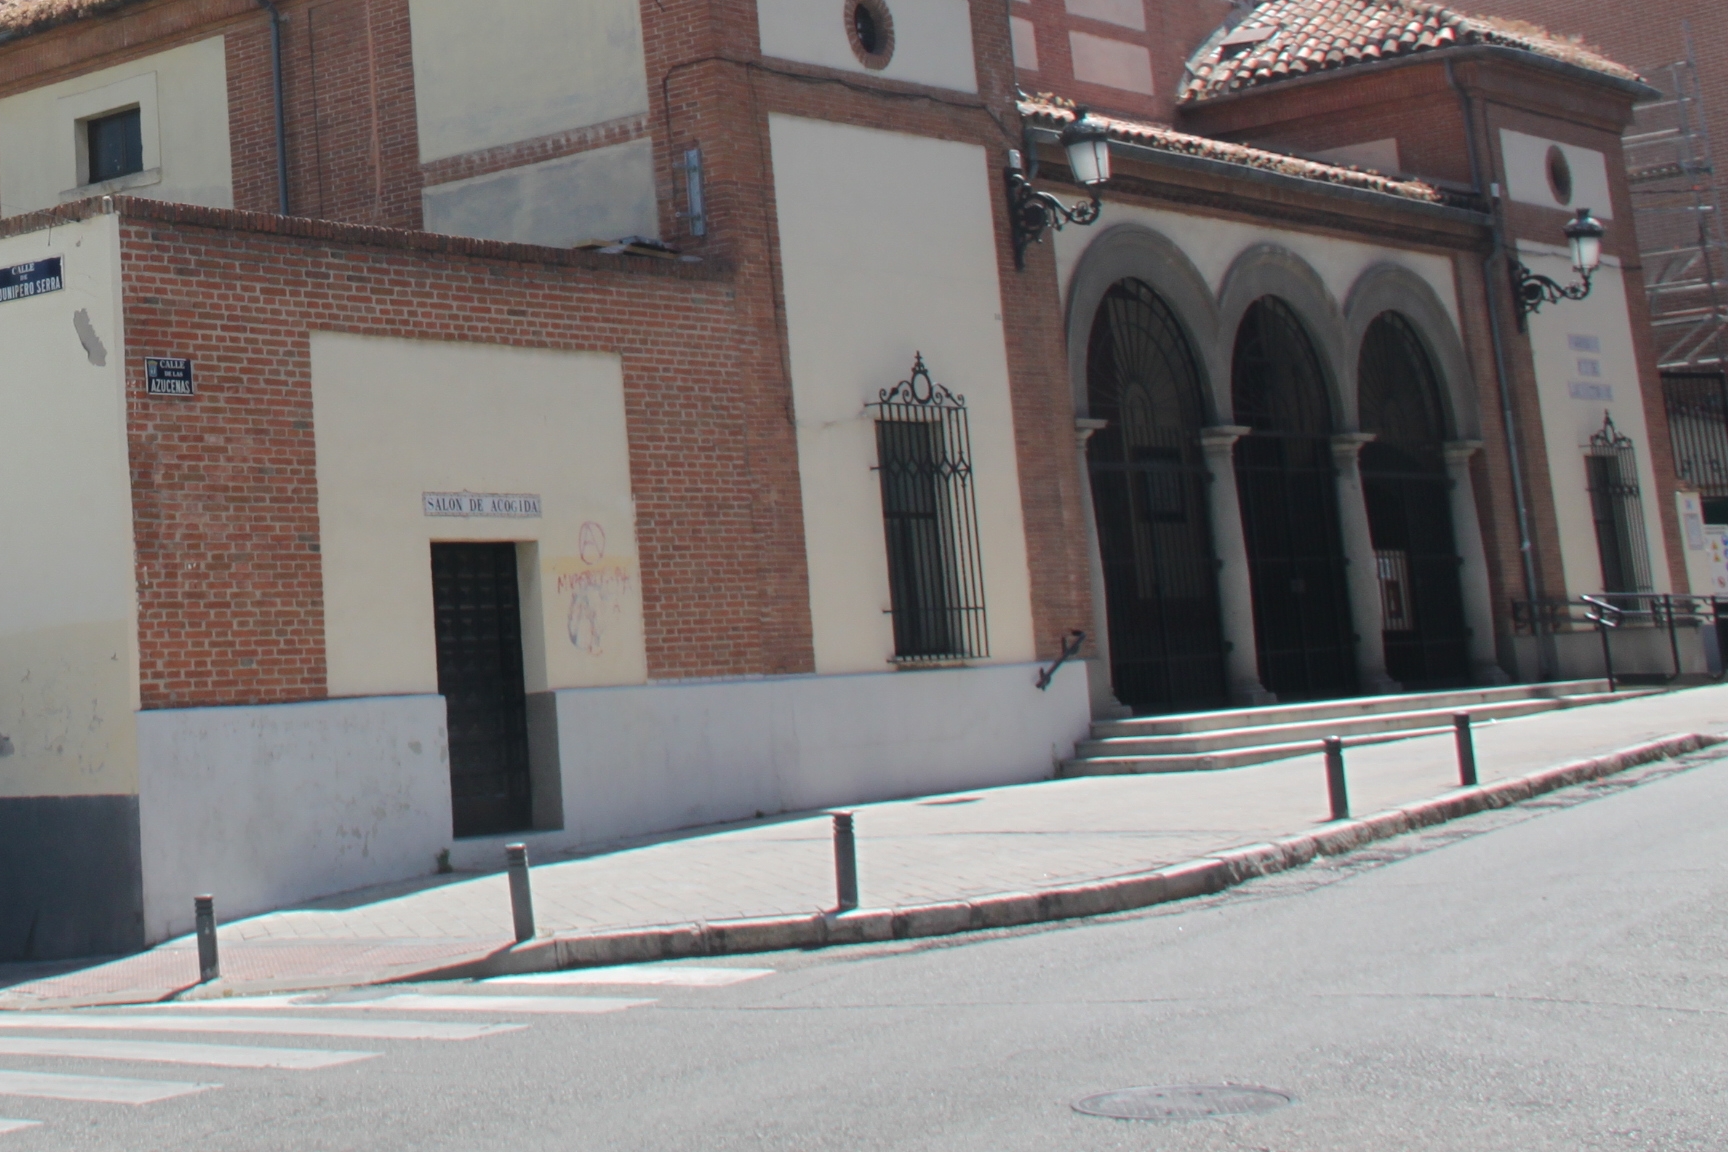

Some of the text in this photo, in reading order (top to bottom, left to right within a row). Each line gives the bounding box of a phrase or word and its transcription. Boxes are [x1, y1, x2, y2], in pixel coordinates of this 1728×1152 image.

[12, 263, 35, 275] CALLE
[36, 276, 60, 293] SERRA
[160, 359, 185, 369] CALLE
[151, 378, 190, 393] AZUCENAS
[427, 497, 538, 513] SALON DE ACOGIDA
